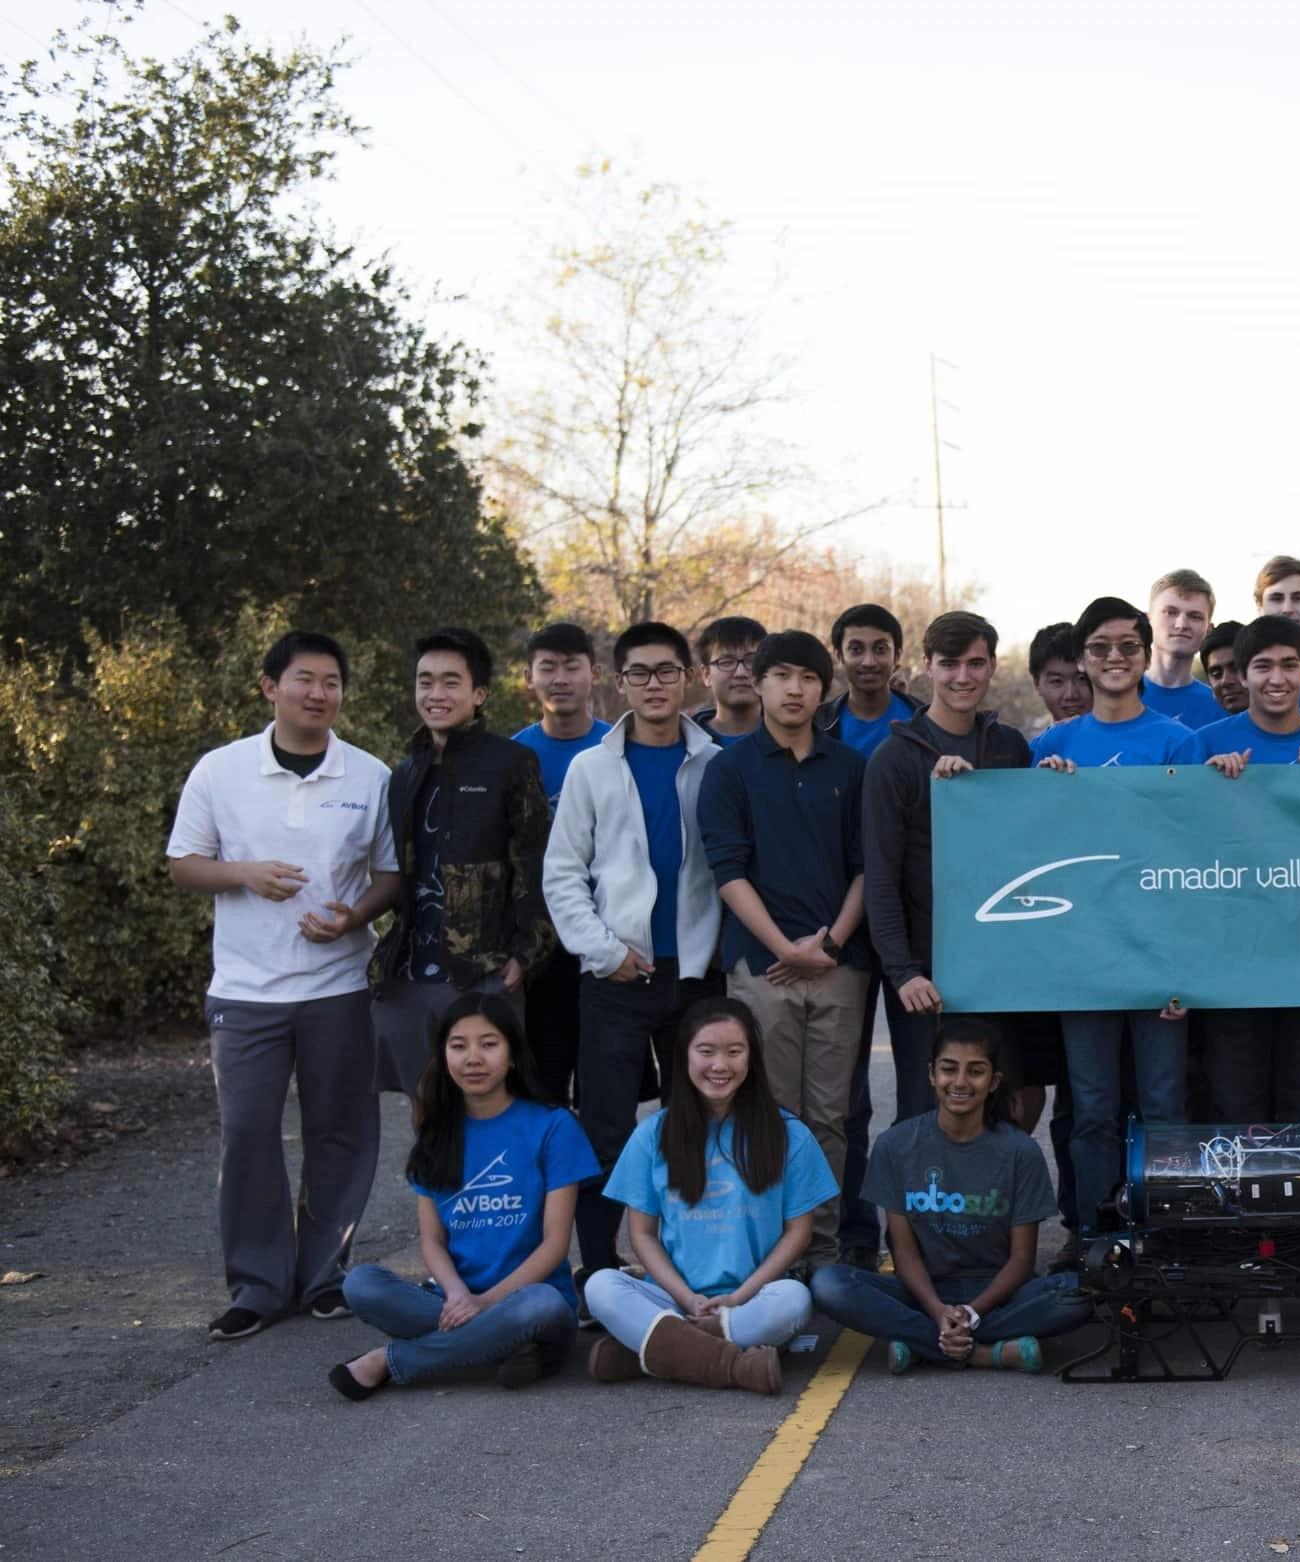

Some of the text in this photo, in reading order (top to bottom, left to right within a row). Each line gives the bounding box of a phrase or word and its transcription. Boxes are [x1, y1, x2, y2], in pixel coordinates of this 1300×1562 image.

[1139, 859, 1249, 890] amador
[452, 1193, 523, 1215] AVBotz
[905, 1183, 1010, 1217] robosub
[494, 1212, 528, 1228] 2017
